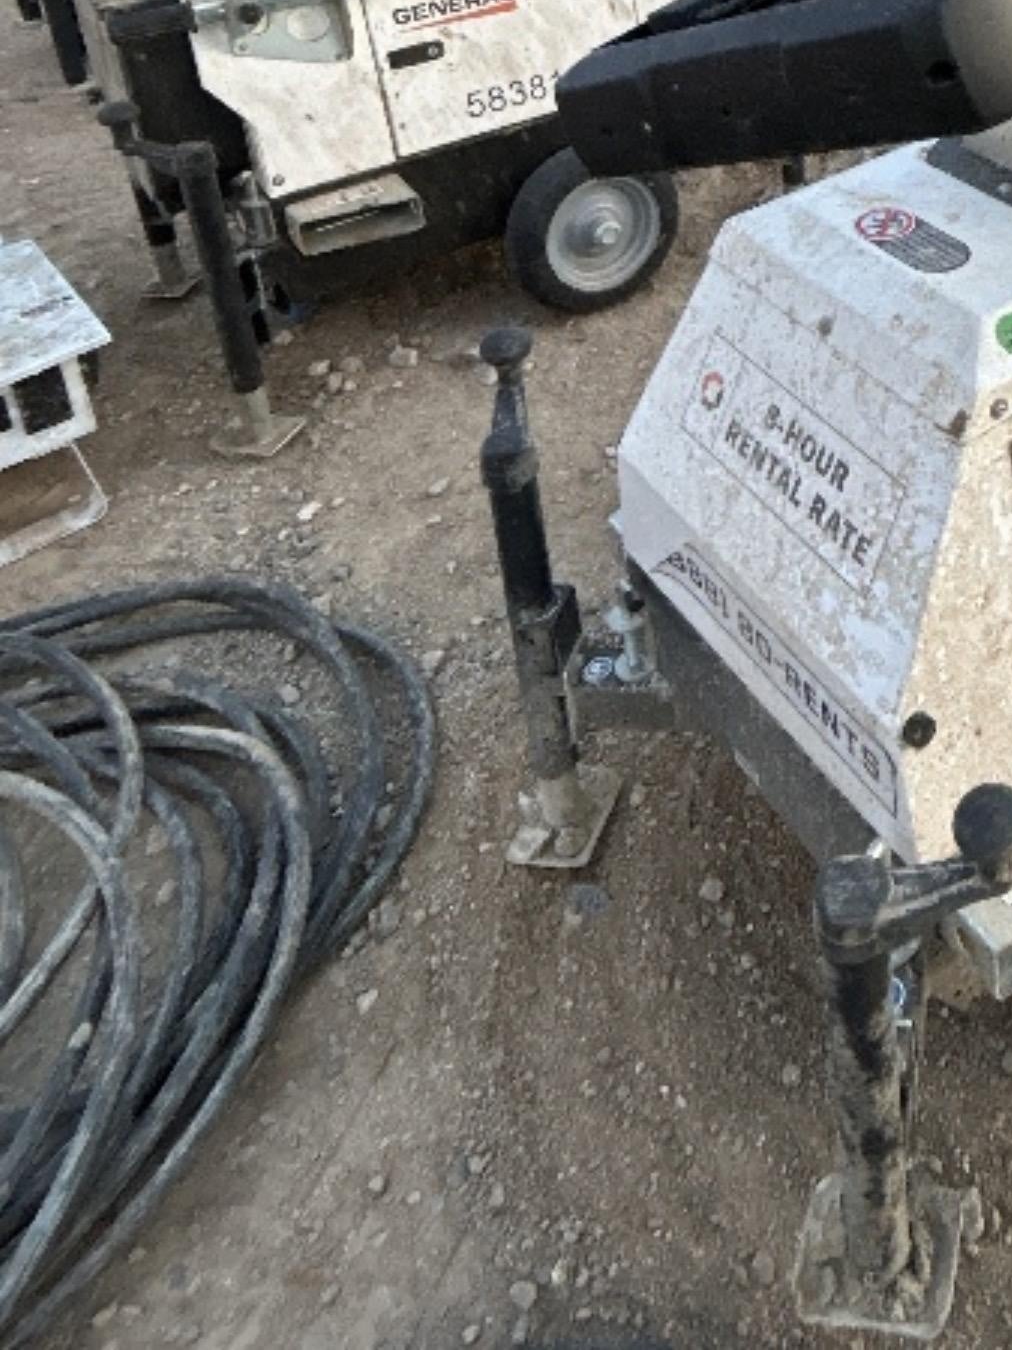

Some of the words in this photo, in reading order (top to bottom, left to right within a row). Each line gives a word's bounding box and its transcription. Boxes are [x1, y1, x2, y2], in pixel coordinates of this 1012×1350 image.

[724, 418, 802, 508] RENTAL
[808, 492, 874, 568] RATE
[764, 403, 850, 493] 8-HOUR
